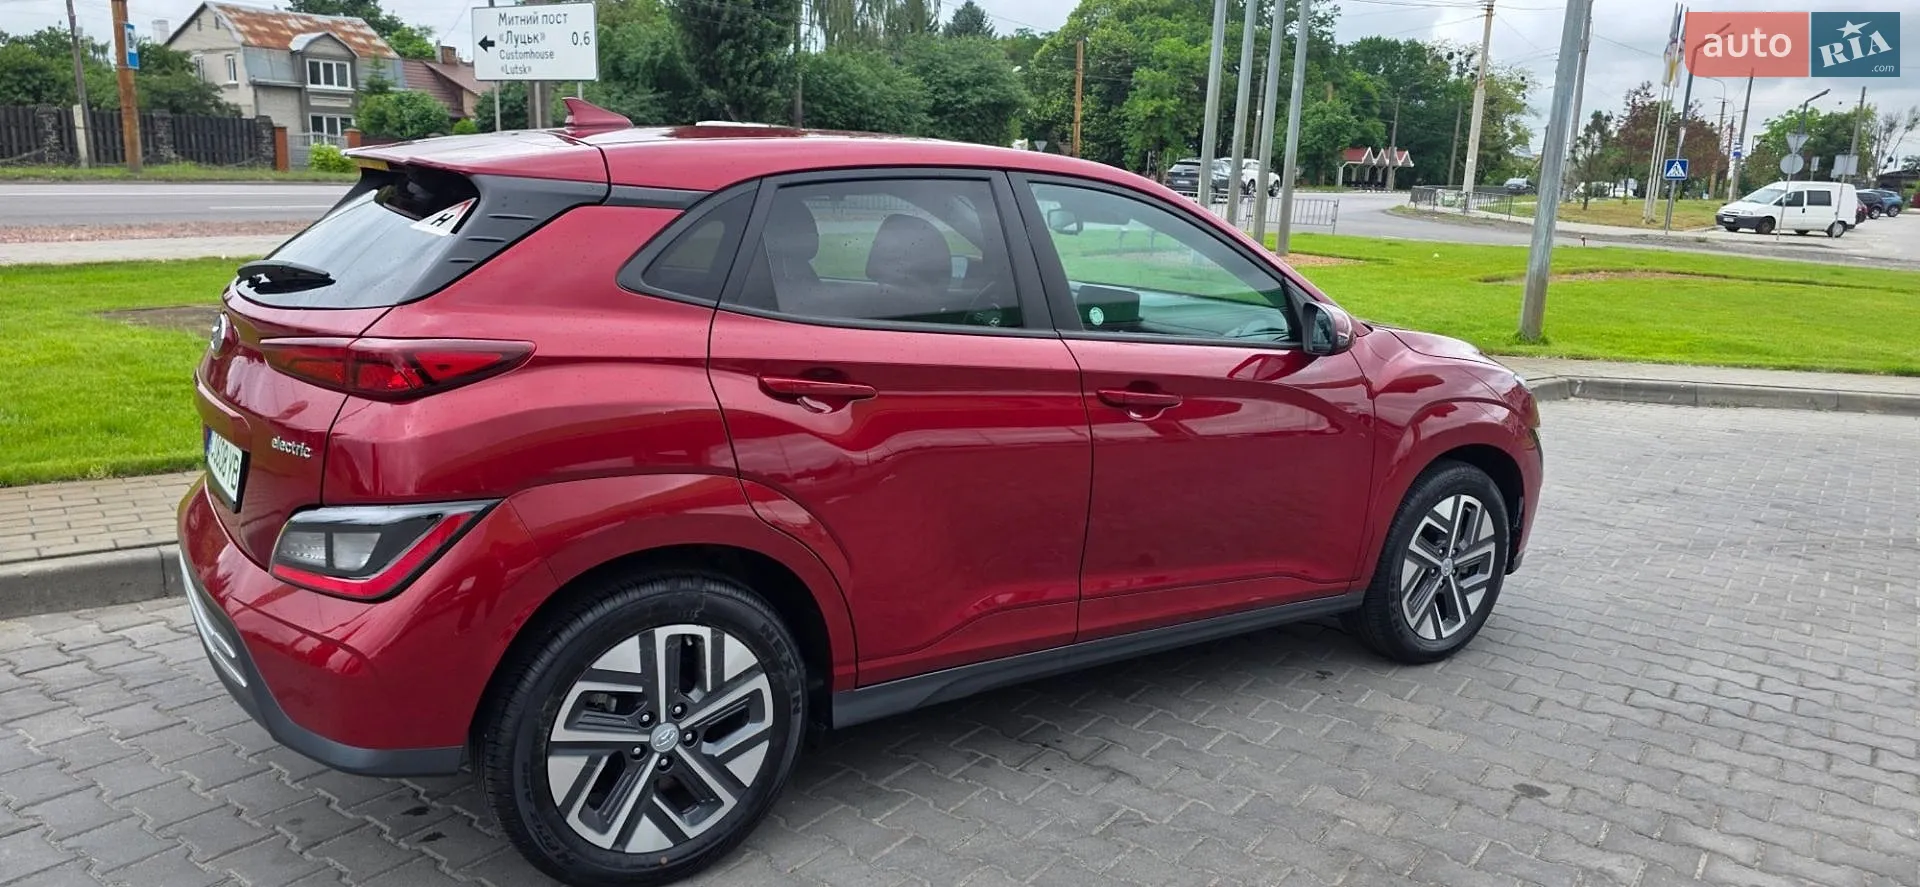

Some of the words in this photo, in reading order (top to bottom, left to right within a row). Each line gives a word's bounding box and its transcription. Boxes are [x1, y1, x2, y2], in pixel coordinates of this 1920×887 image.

[498, 11, 539, 26] Митний
[541, 13, 568, 25] пост
[499, 30, 546, 48] «Луцьк»
[571, 31, 591, 46] 0.6
[499, 49, 555, 60] Customhouse
[501, 63, 532, 75] «Lutsk»
[271, 436, 312, 458] electric
